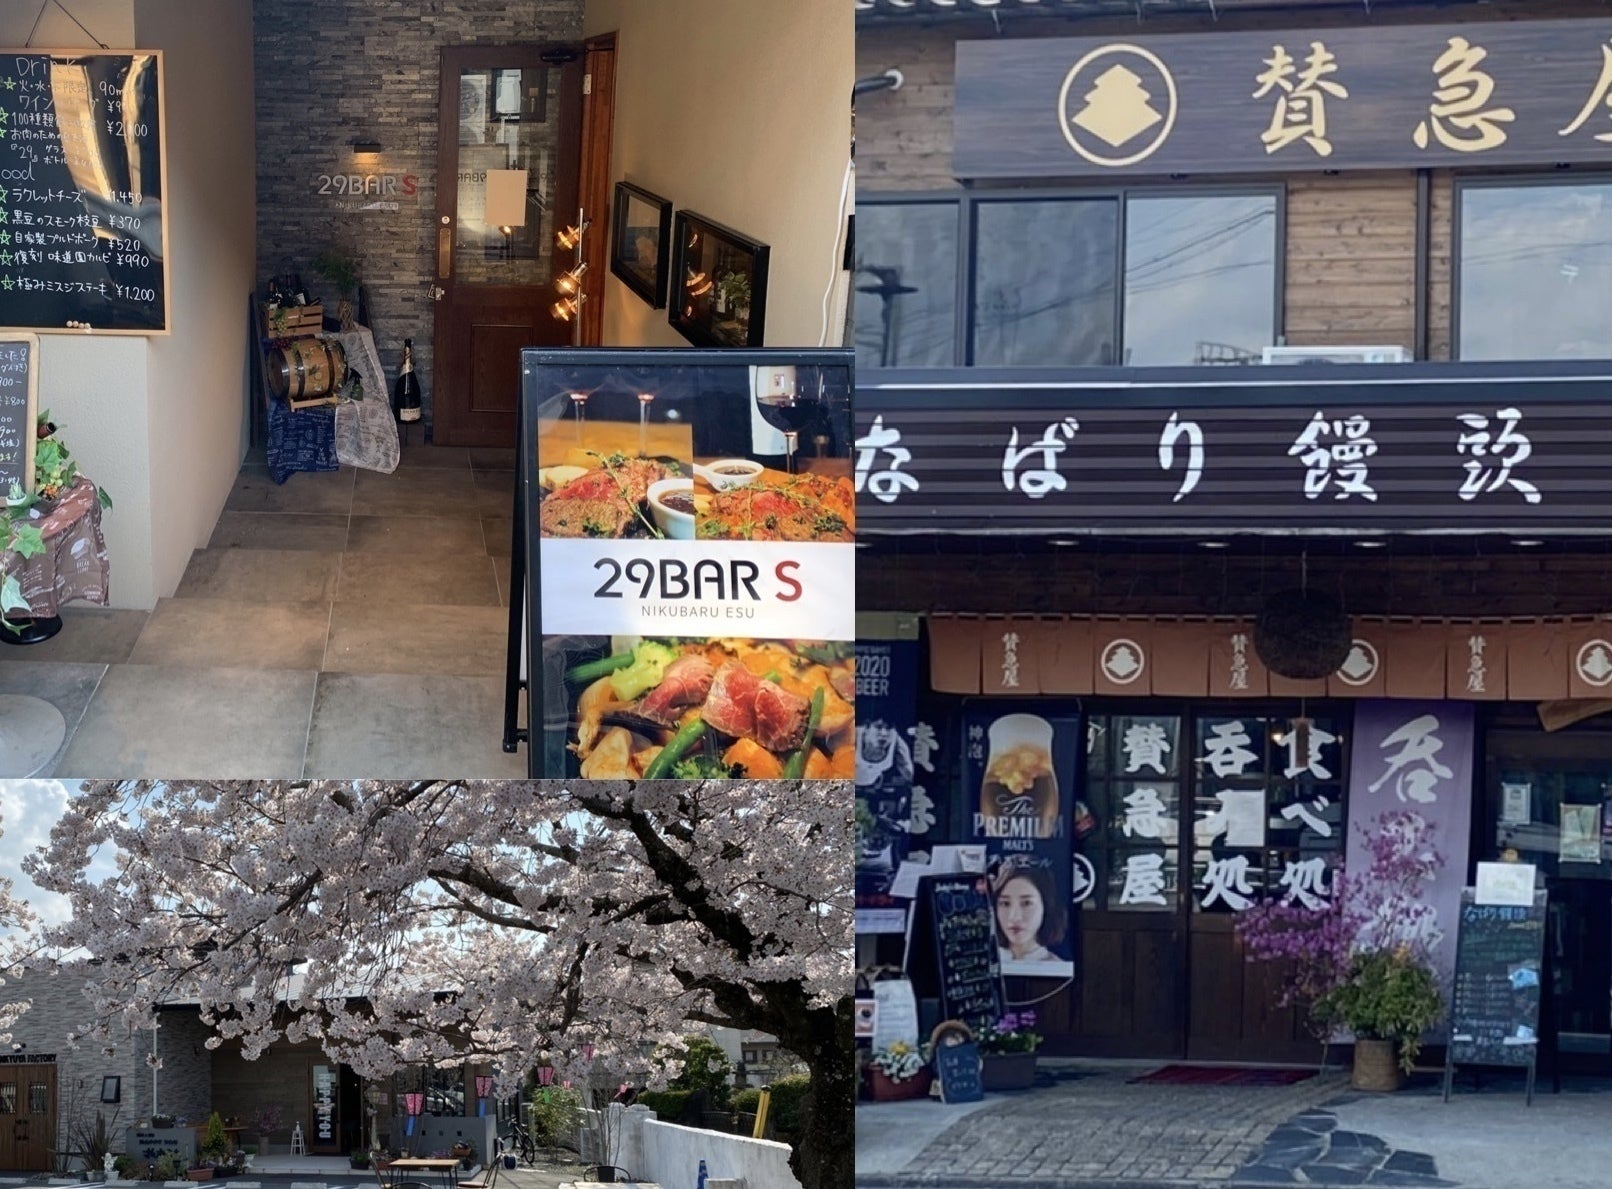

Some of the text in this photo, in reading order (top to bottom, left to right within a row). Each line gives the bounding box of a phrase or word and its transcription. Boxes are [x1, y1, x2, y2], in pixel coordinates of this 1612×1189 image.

[107, 120, 148, 137] ¥200
[318, 174, 417, 195] 29BAR S
[12, 210, 140, 229] 黒豆のスモーク枝豆 ¥370
[108, 239, 140, 251] ¥520
[117, 253, 149, 268] ¥990
[855, 407, 1541, 505] なばり饅頭
[594, 557, 803, 602] 29BAR S
[641, 605, 755, 619] NIKUBARU ESU
[855, 655, 891, 678] 2020
[855, 678, 889, 696] BEER
[995, 795, 1036, 816] The
